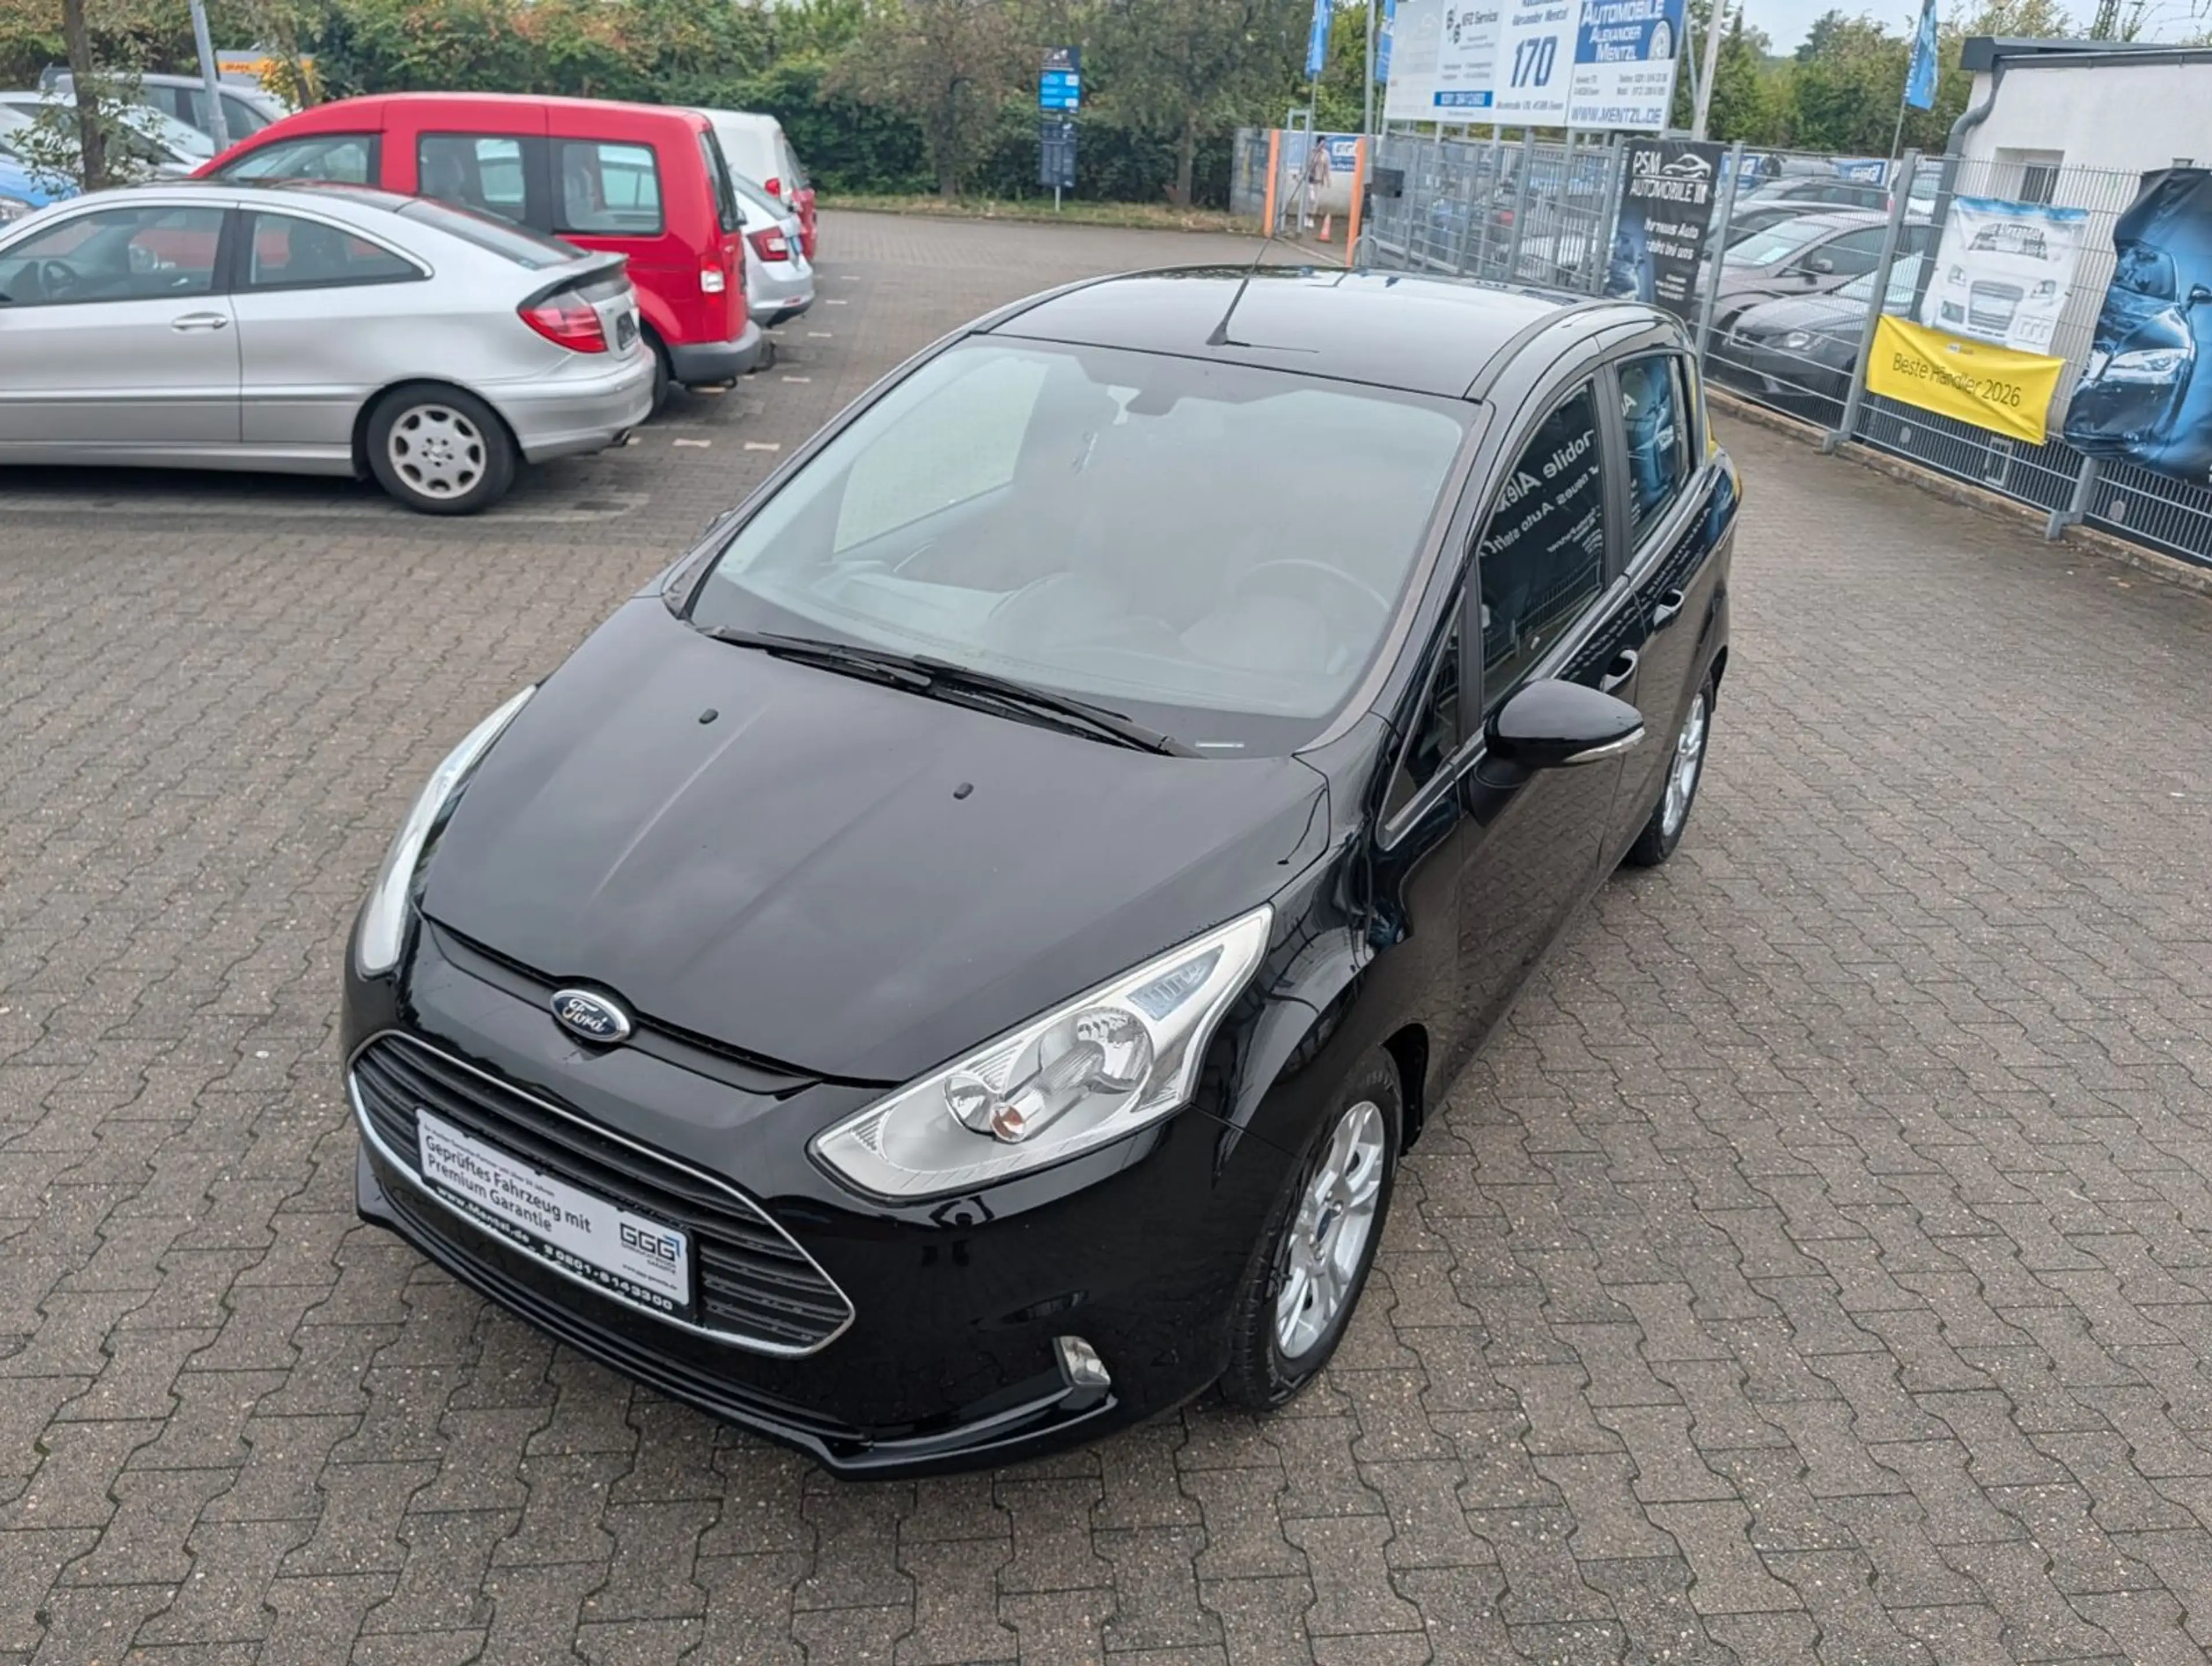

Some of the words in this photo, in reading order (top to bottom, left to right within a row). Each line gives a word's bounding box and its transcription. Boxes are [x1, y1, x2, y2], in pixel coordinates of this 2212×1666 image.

[1589, 25, 1642, 43] ALEXANDER
[1595, 42, 1636, 62] MENTZL
[1510, 35, 1558, 87] 170
[1632, 150, 1662, 175] PSM
[1629, 179, 1694, 202] AUTOMOBILE
[1677, 223, 1700, 239] Auto
[1893, 352, 1928, 379] Beste
[1928, 365, 1983, 396] Händler
[1982, 379, 2022, 407] 2026
[562, 997, 609, 1033] Ford
[425, 1134, 491, 1183] Geprüftes
[494, 1171, 561, 1222] Fahrzeug
[564, 1211, 592, 1234] mit
[428, 1152, 487, 1199] Premium
[489, 1188, 553, 1232] Garantie
[620, 1222, 676, 1262] GGG
